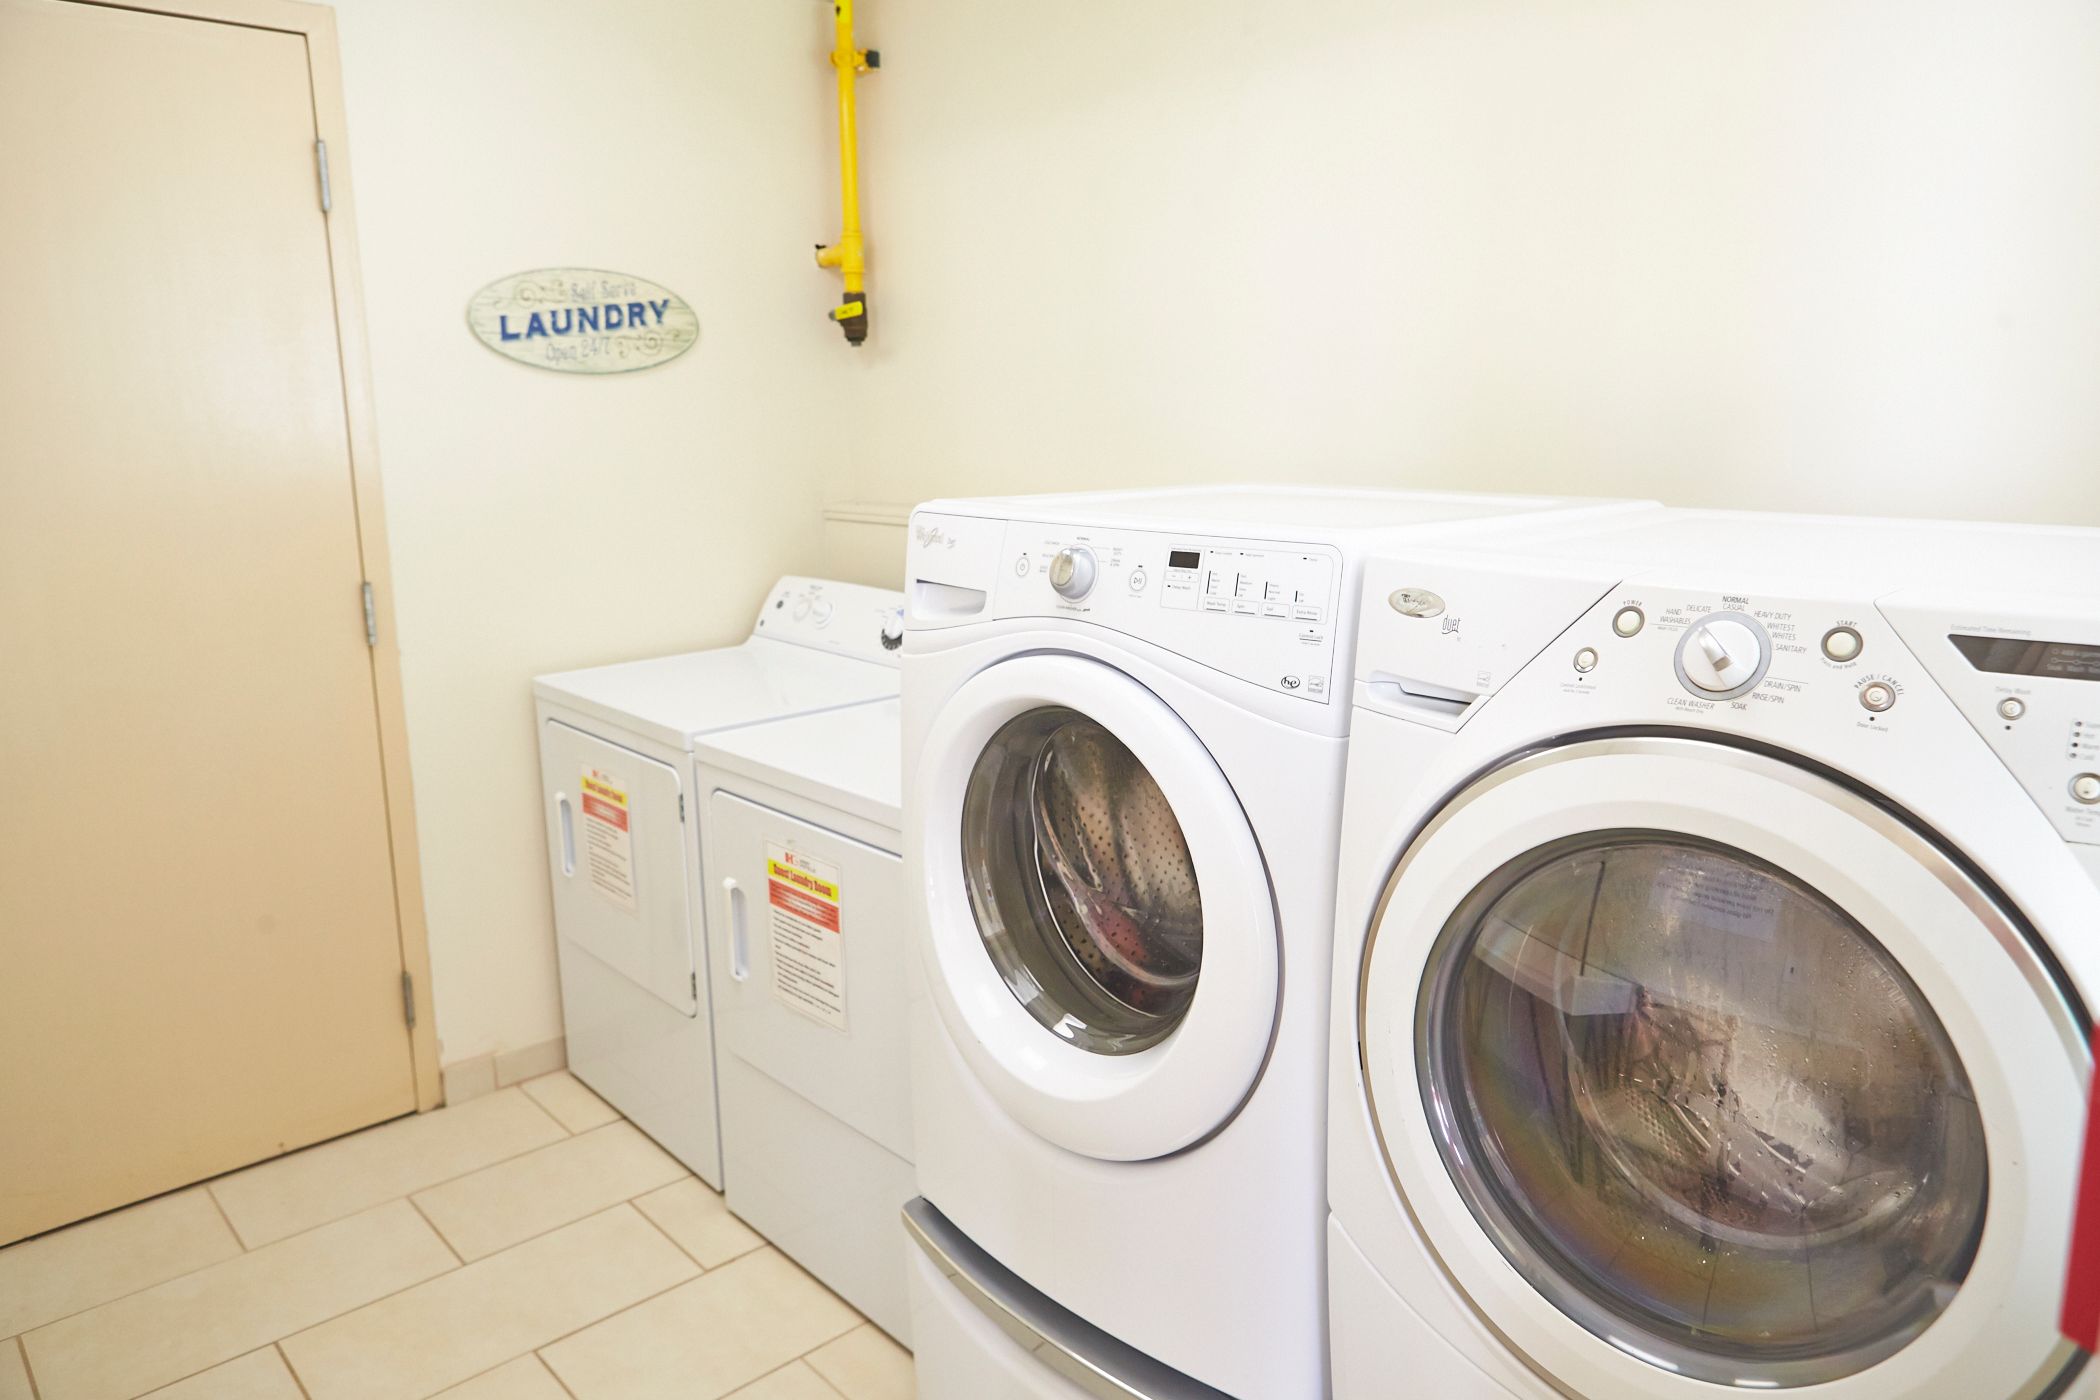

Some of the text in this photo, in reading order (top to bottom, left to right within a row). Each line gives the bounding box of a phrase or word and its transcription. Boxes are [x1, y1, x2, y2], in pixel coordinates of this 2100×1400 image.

[500, 299, 671, 342] LAUNDRY
[1623, 599, 1643, 607] POWER
[1722, 596, 1749, 605] NORMAL
[1686, 604, 1711, 613] DELICATE
[1722, 603, 1745, 612] CASUAL
[1660, 616, 1691, 625] WASHABLES
[1754, 610, 1792, 621] HEAVY DUTY
[1442, 614, 1461, 631] duet
[1767, 622, 1796, 632] WHITEST
[1772, 632, 1797, 641] WHITES
[1776, 643, 1808, 654] SANITARY
[1282, 677, 1297, 688] he
[1854, 674, 1875, 689] PAUSE
[1881, 674, 1904, 696] CANCEL
[1666, 698, 1687, 707] CLEAN
[1688, 700, 1715, 710] WASHER
[1731, 702, 1748, 711] SOAK
